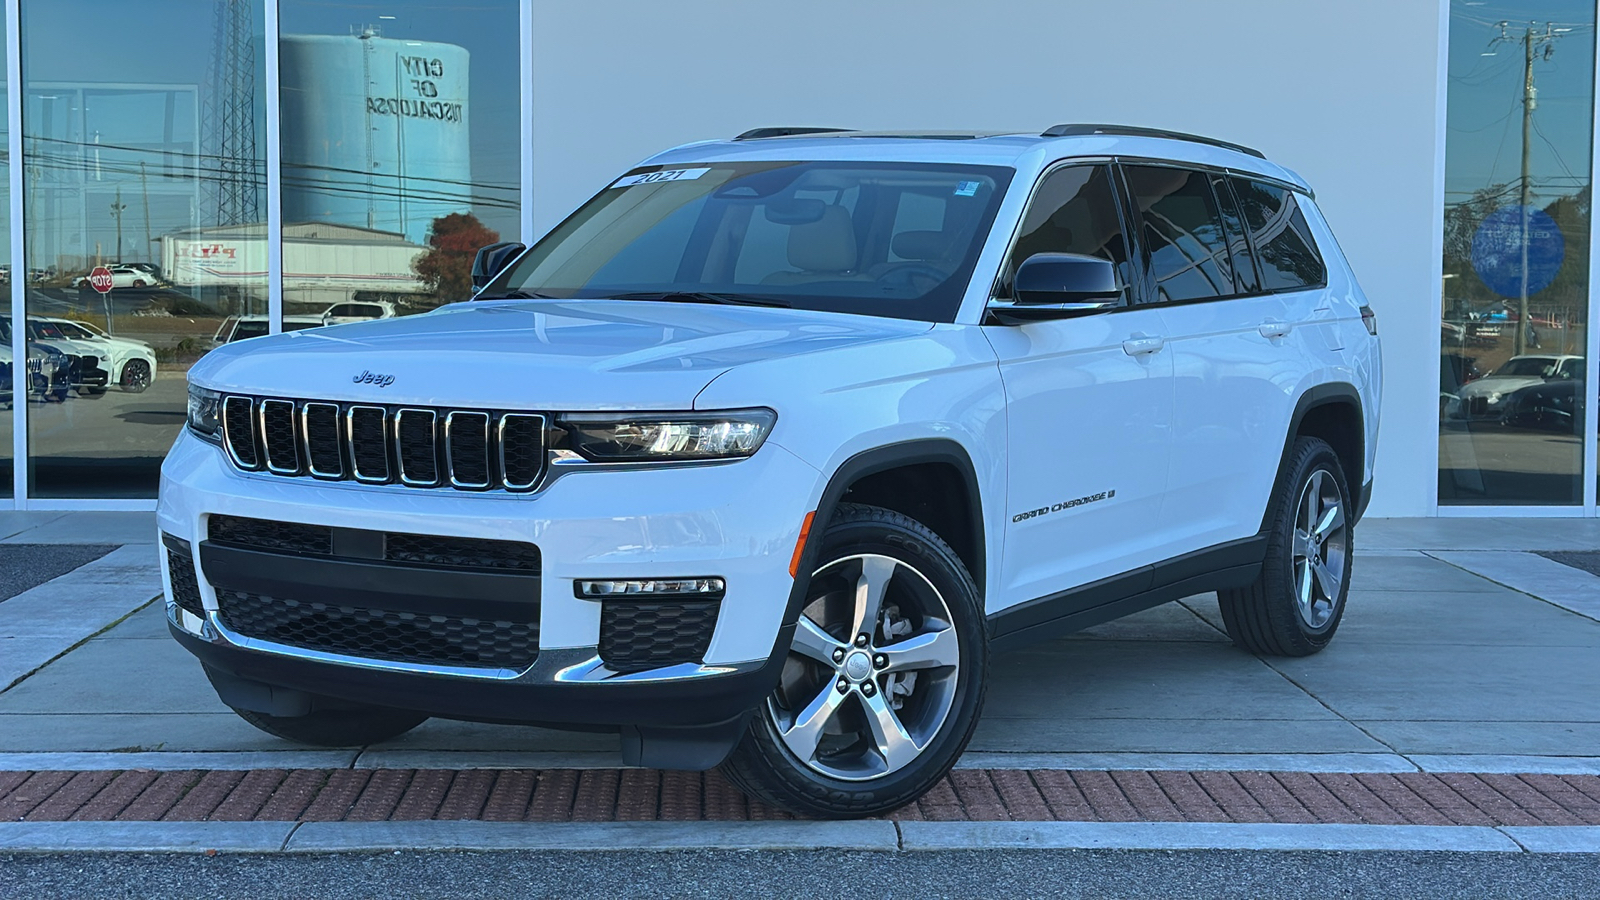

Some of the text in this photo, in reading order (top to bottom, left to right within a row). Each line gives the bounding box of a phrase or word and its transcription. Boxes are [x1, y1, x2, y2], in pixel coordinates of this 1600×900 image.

[631, 170, 687, 185] 2021
[353, 370, 395, 388] Jeep
[1012, 506, 1050, 523] GRAND
[1051, 491, 1107, 512] CHEROKEE
